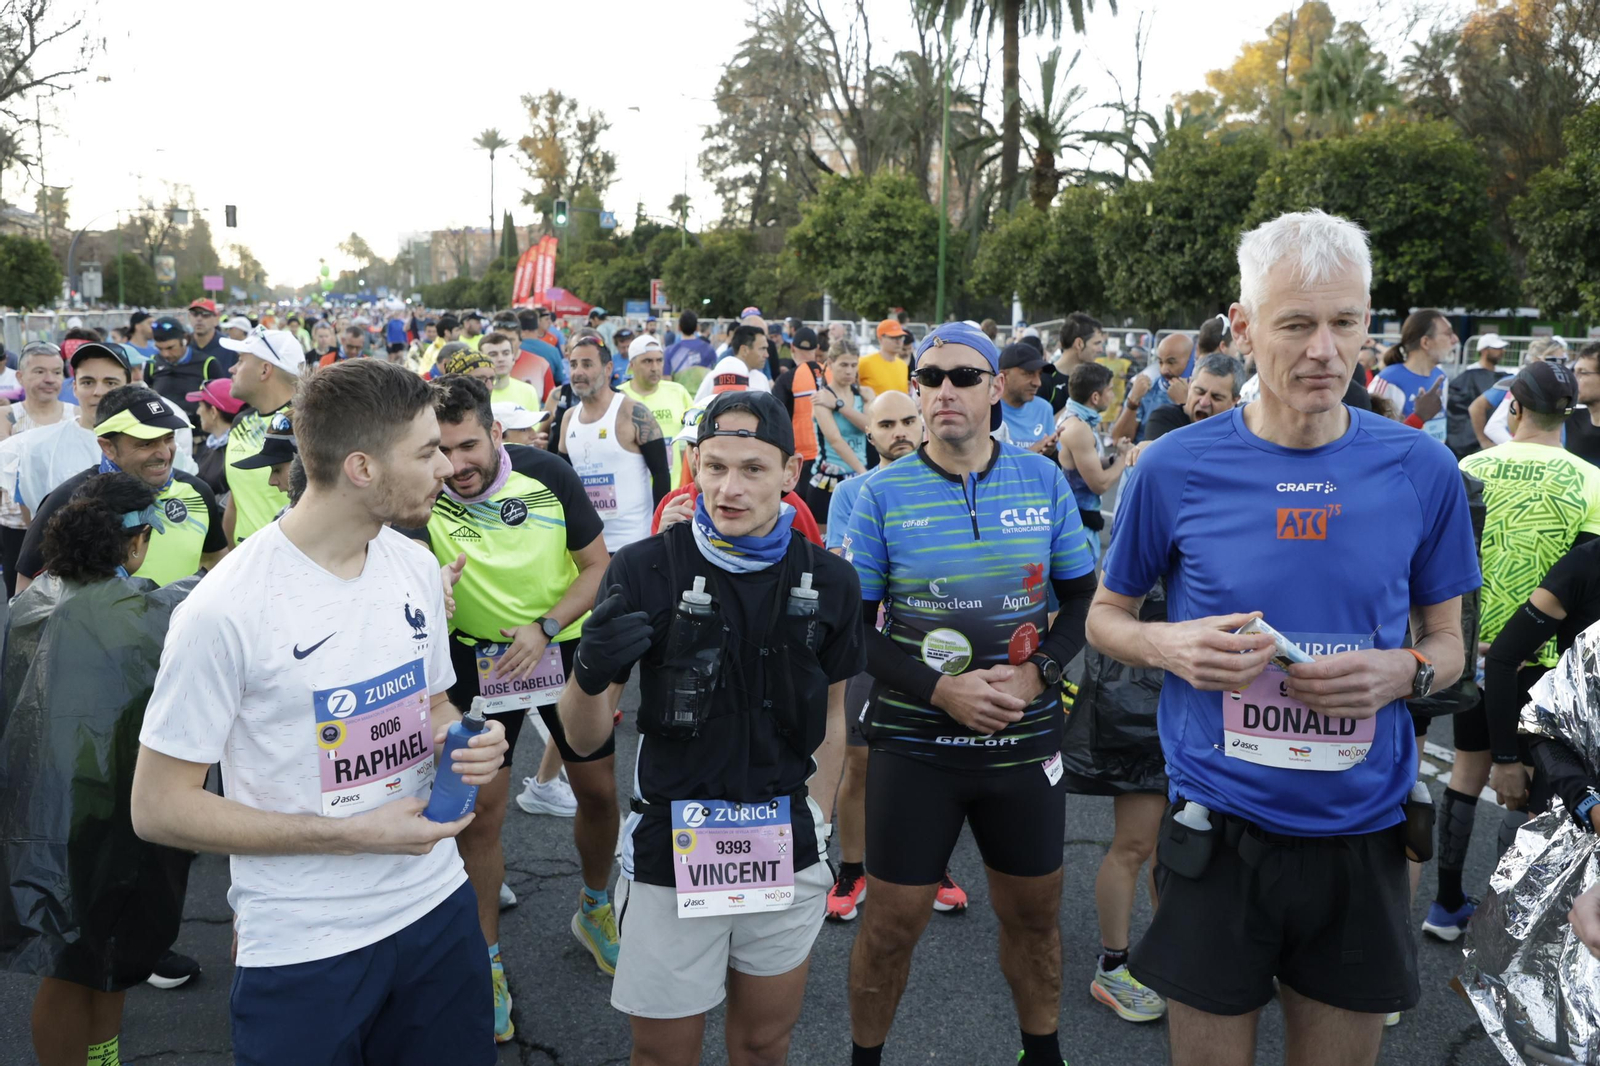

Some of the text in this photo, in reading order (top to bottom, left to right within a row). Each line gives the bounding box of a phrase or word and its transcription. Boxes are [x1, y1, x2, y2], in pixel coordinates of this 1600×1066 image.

[583, 476, 609, 485] ZURICH
[1276, 482, 1324, 492] CRAFT
[592, 499, 617, 509] AOLO
[1002, 595, 1030, 611] Agro
[365, 671, 416, 705] ZURICH
[481, 673, 564, 697] JOSE CABELLO
[1243, 703, 1357, 736] DONALD
[371, 716, 401, 741] 8006
[1240, 742, 1259, 751] asics
[334, 731, 428, 784] RAPHAEL
[714, 806, 777, 821] ZURICH
[716, 840, 751, 854] 9393
[688, 860, 780, 887] VINCENT
